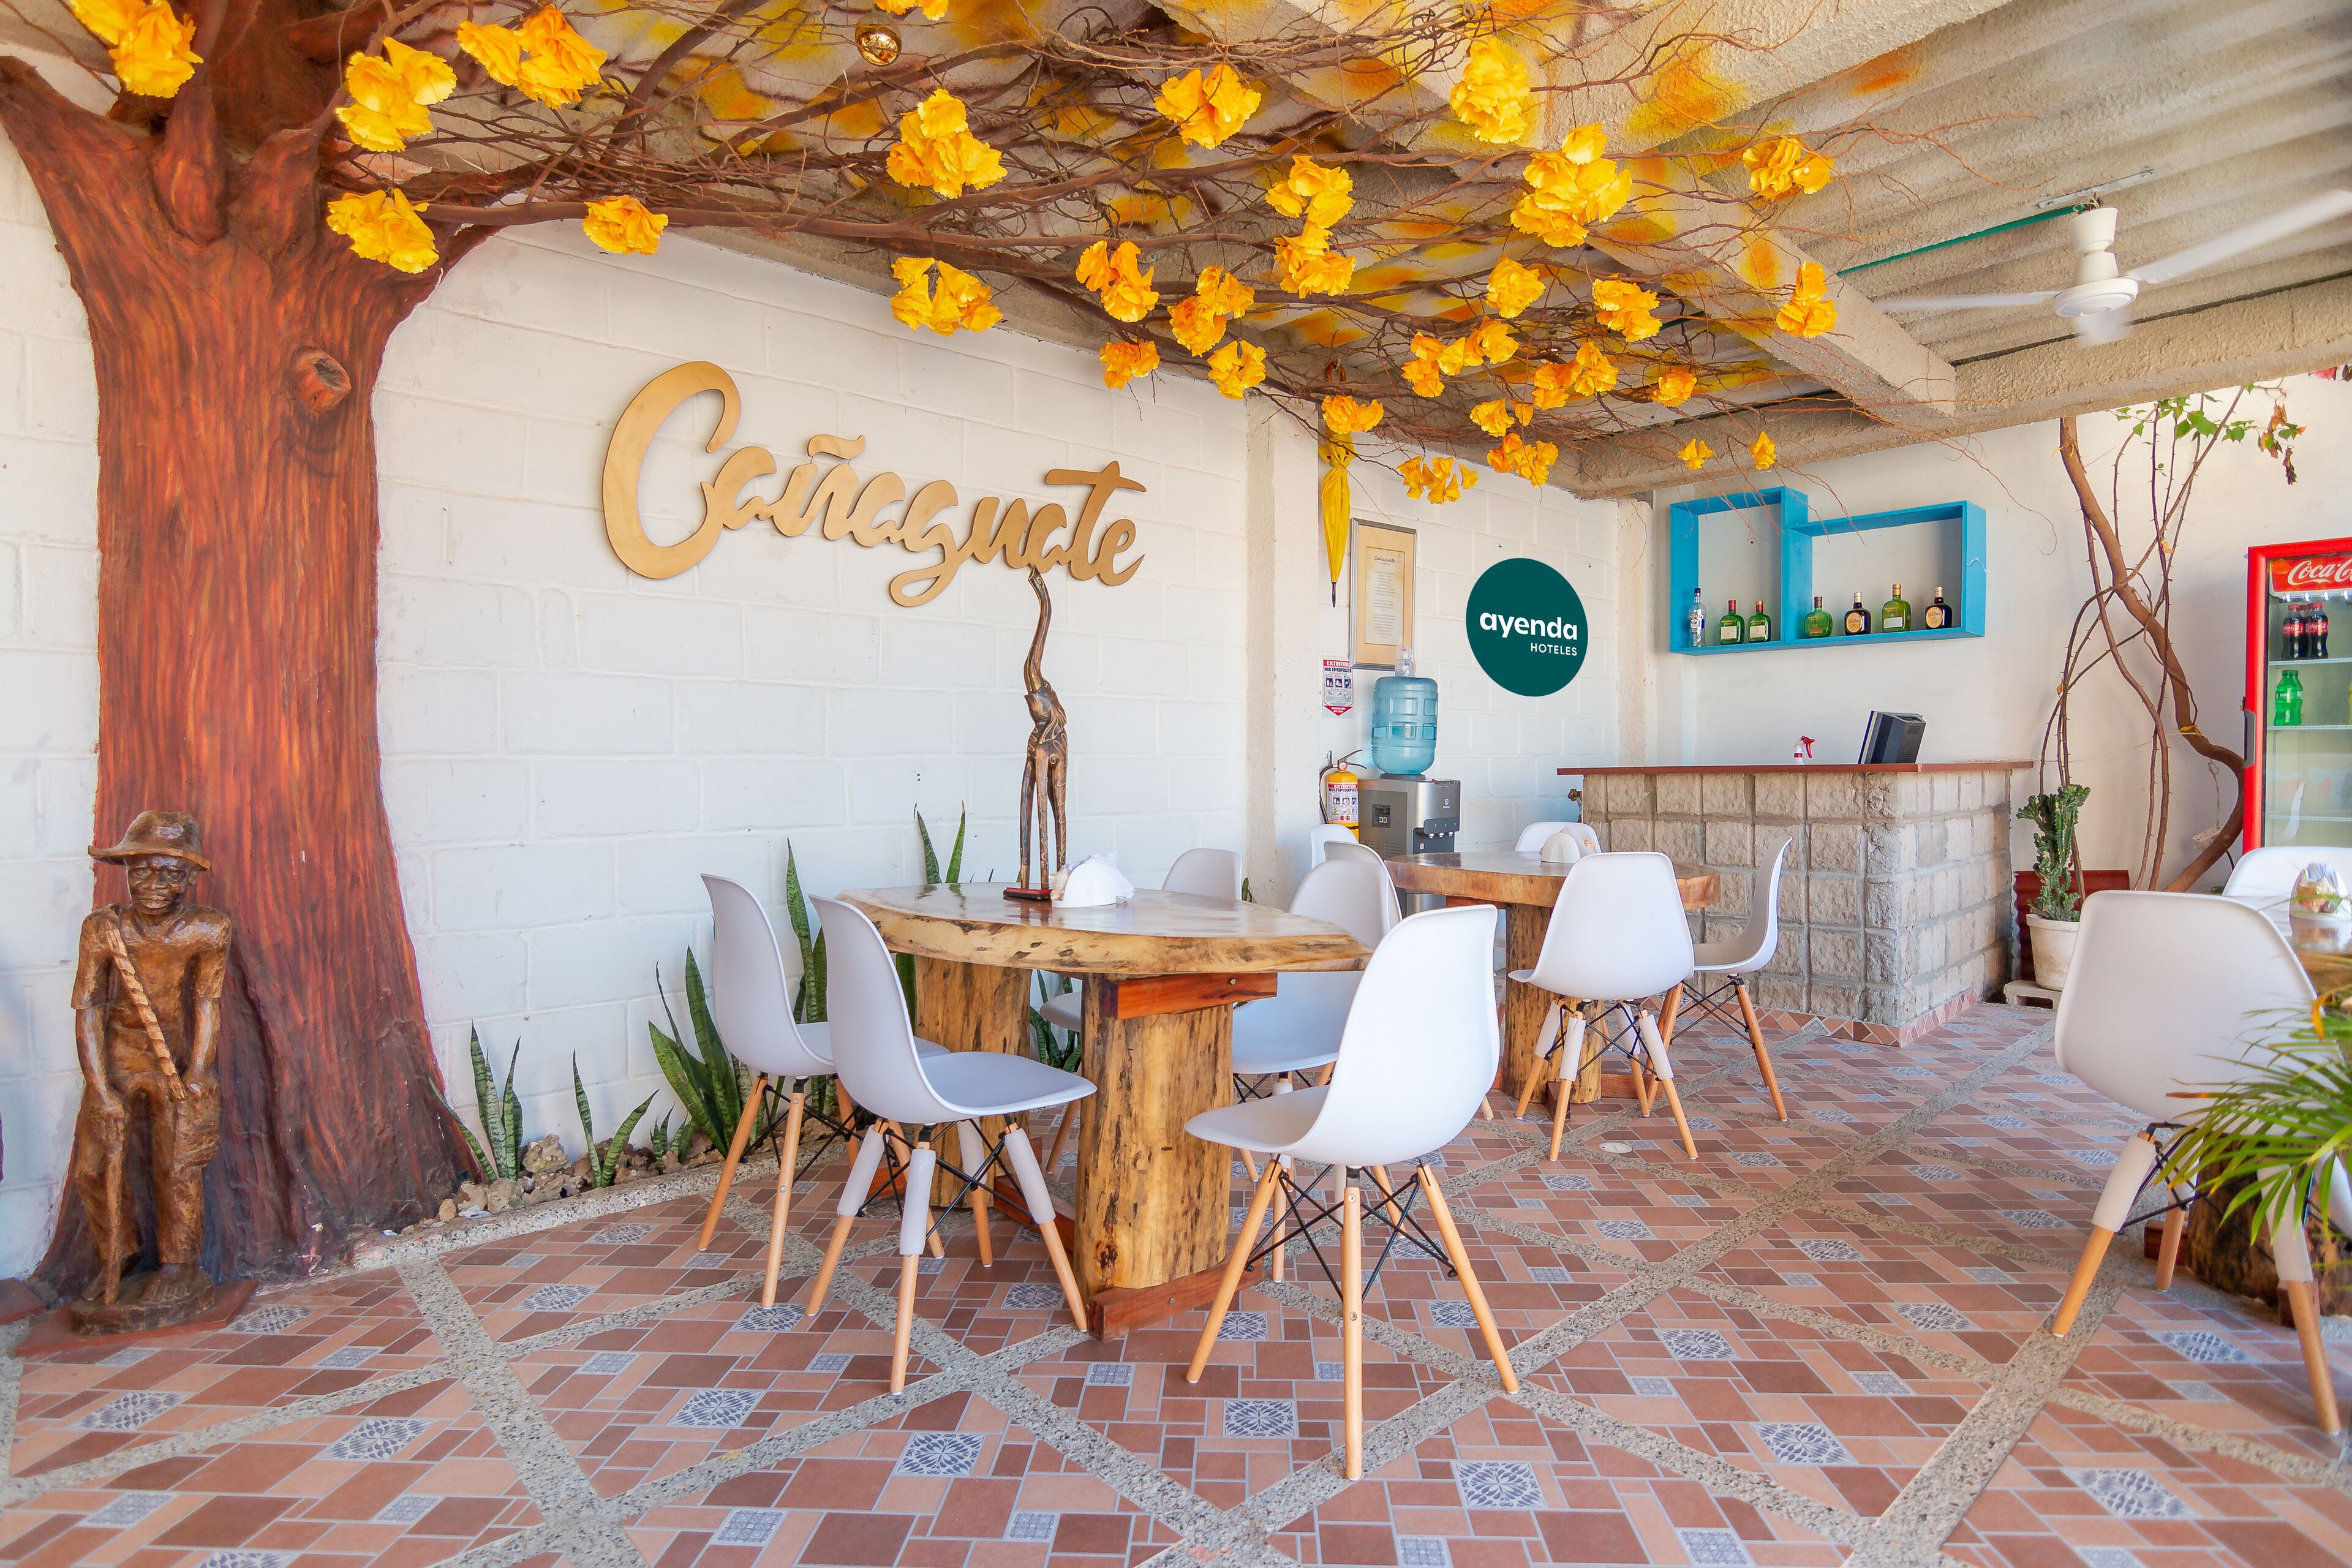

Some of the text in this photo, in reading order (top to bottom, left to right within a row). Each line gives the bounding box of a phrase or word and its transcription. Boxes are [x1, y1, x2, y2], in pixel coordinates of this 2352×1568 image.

[602, 360, 1147, 608] Cañaguate
[1479, 612, 1578, 640] ayenda
[1531, 643, 1578, 656] HOTELES
